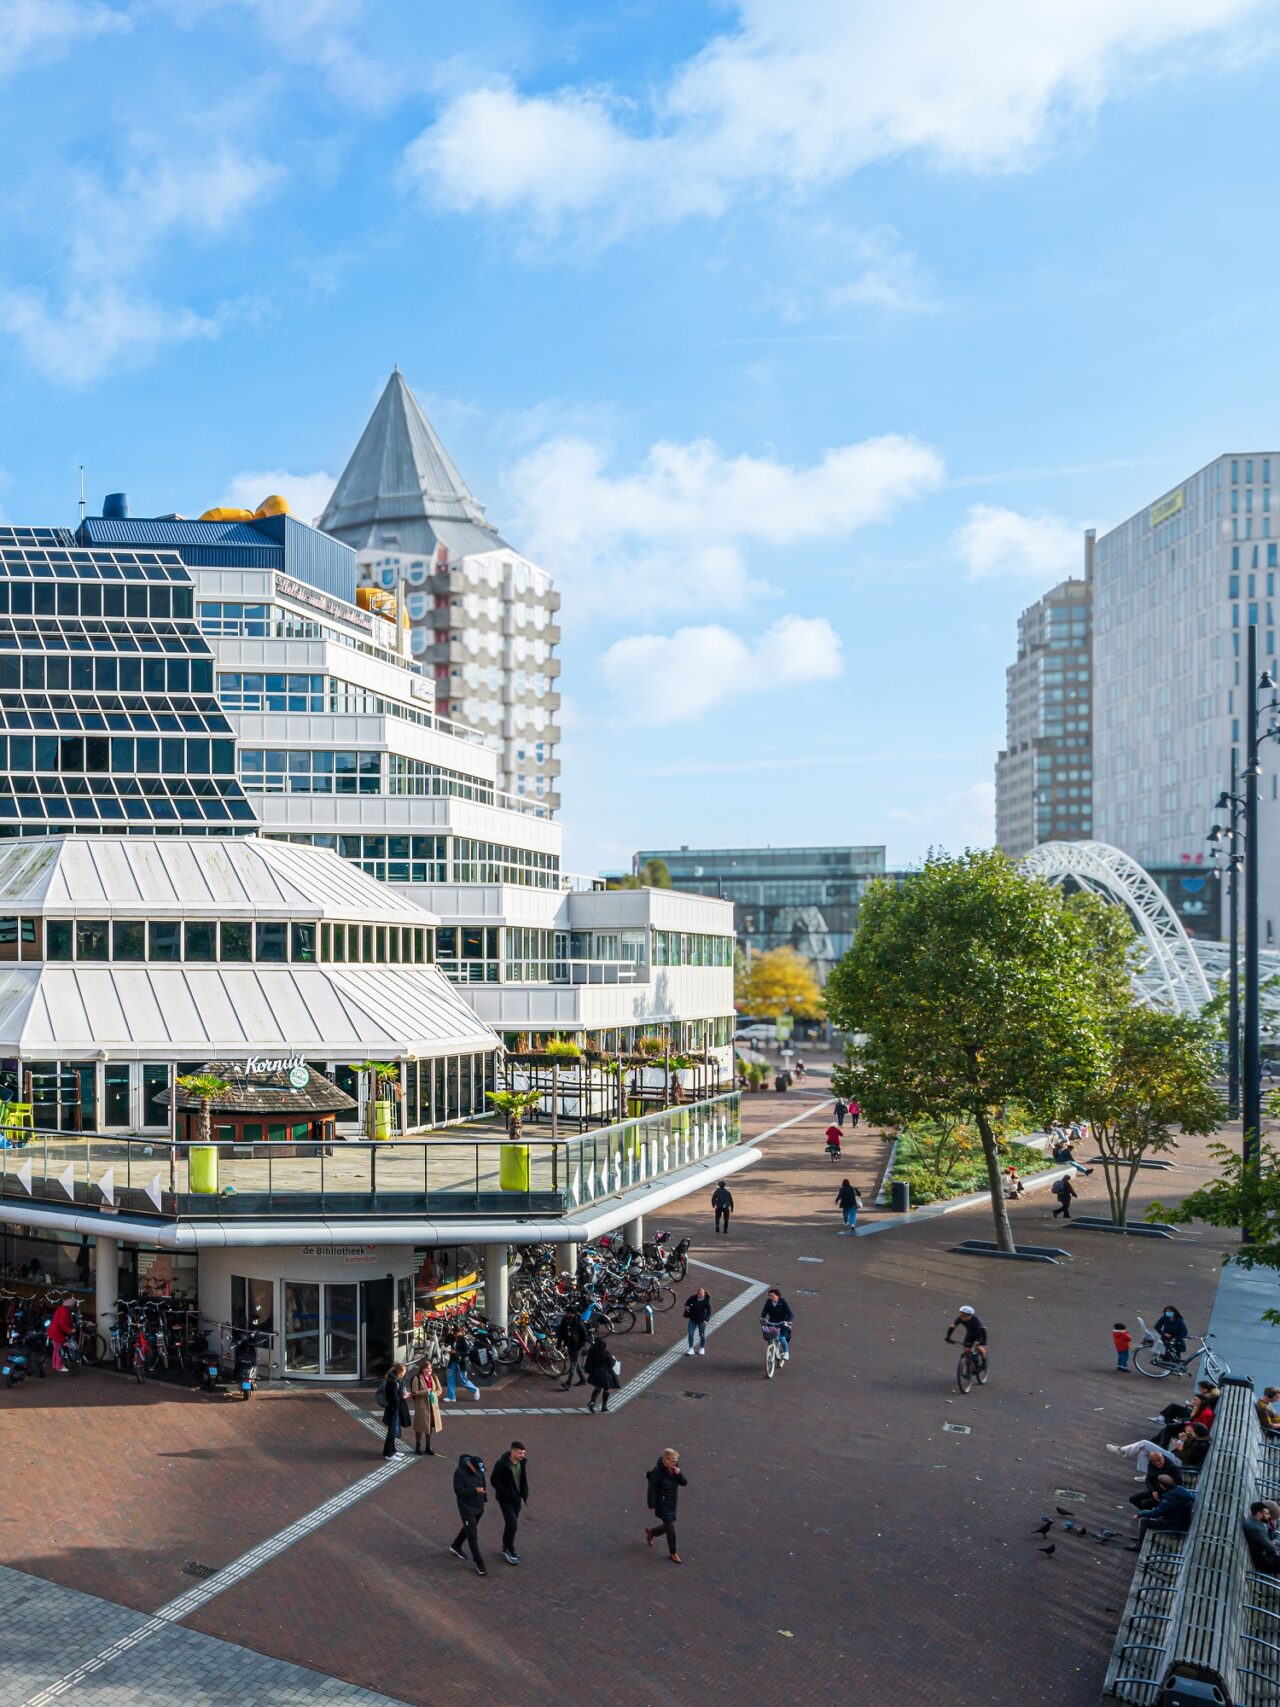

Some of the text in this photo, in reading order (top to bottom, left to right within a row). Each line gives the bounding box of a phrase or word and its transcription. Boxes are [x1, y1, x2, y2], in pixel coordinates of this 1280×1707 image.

[245, 1053, 307, 1075] Kornuit
[302, 1246, 366, 1256] de Bibliotheek
